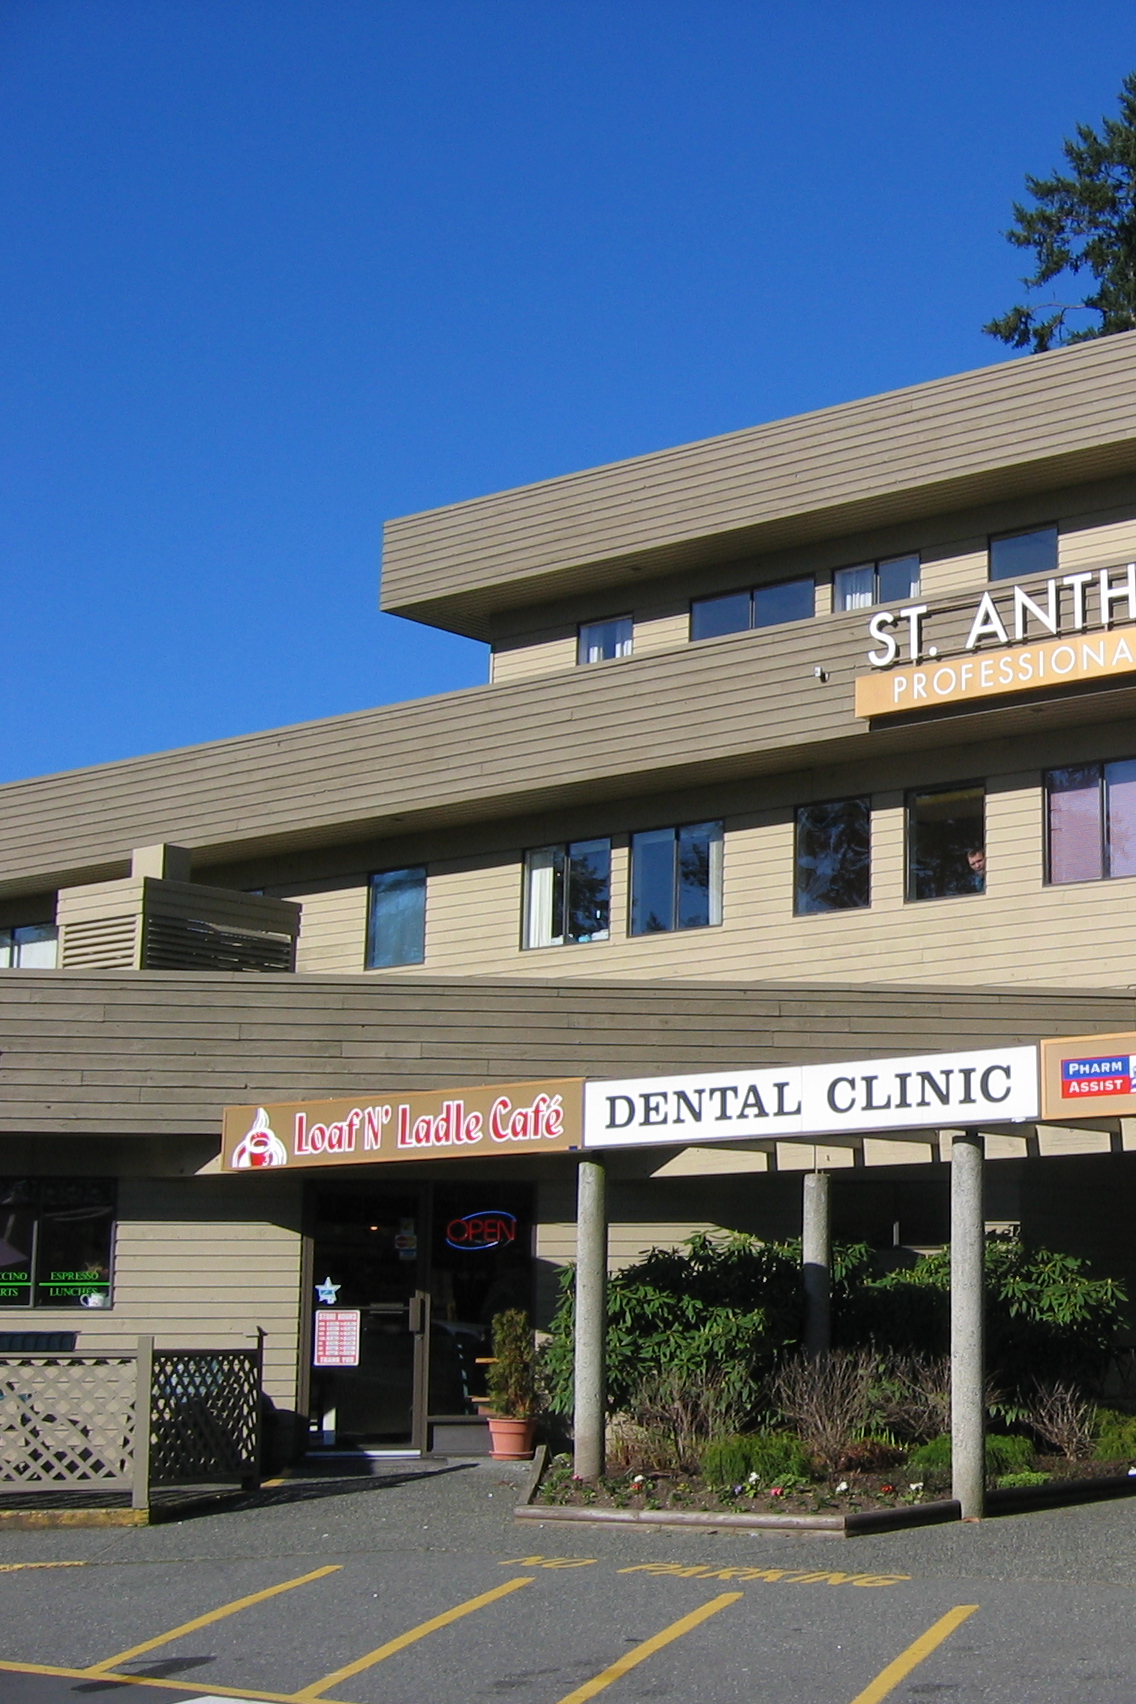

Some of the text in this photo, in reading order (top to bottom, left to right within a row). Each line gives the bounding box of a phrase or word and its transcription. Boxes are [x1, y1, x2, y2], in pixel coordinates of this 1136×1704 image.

[867, 604, 938, 668] ST.
[1068, 1061, 1123, 1076] PHARM
[604, 1064, 1013, 1130] DENTAL CLINIC
[1068, 1079, 1124, 1094] ASSIST
[293, 1107, 362, 1156] Loaf
[397, 1100, 484, 1150] Ladle
[488, 1092, 565, 1143] Café
[446, 1219, 516, 1241] OPEN
[50, 1271, 100, 1281] ESPRESSO
[497, 1555, 913, 1588] NO PARKING
